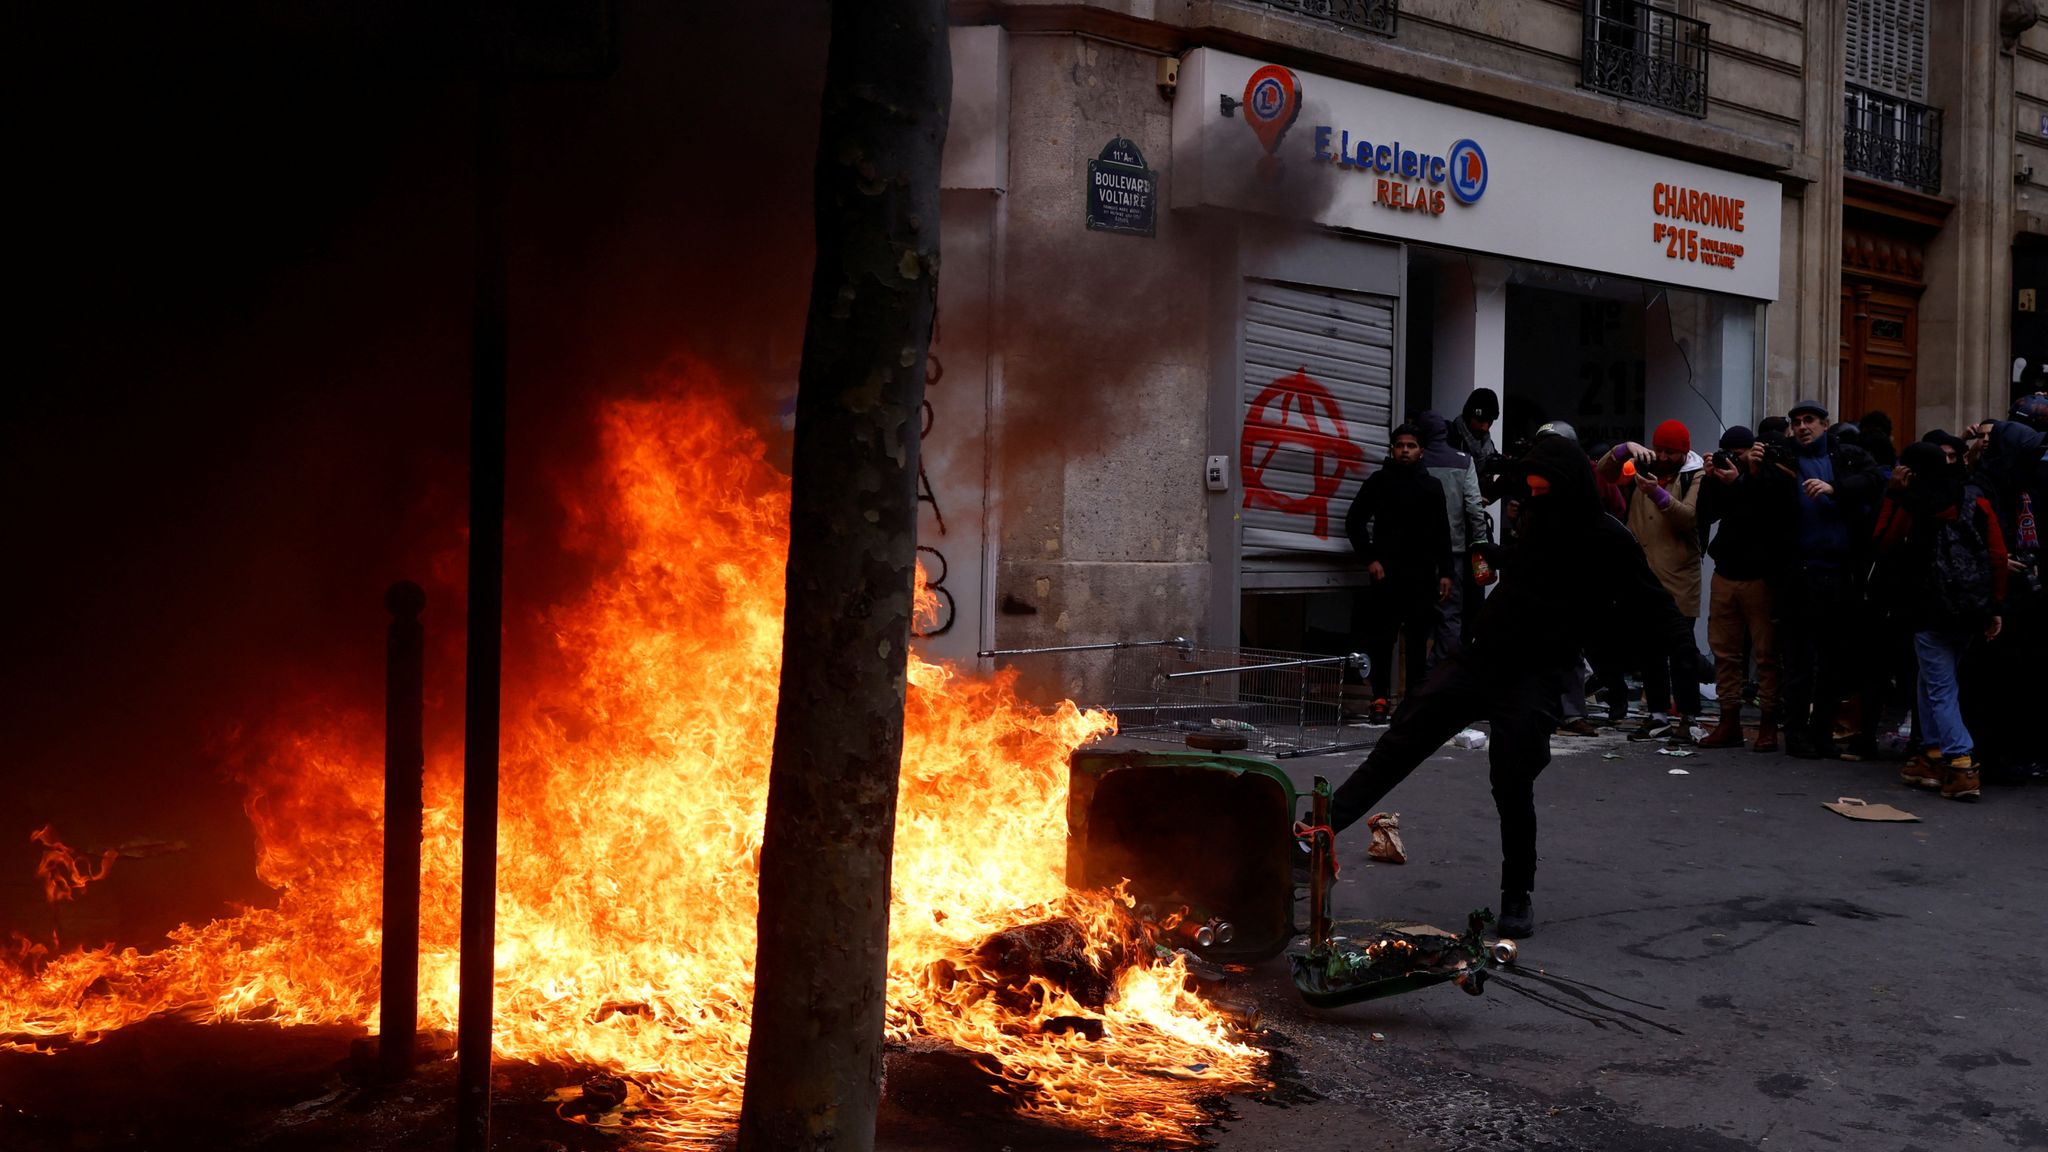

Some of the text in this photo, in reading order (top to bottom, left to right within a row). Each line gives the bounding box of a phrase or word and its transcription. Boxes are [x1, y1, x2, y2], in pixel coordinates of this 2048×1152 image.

[1314, 126, 1446, 184] E.Leclerc
[1095, 171, 1151, 194] BOULEVARD
[1377, 179, 1446, 214] RELAIS
[1099, 188, 1148, 208] VOLTAIRE
[1653, 182, 1745, 232] CHARONNE
[1666, 226, 1698, 262] 215
[1700, 238, 1744, 257] BOULEVARD
[1700, 252, 1735, 270] VOLTAIRE
